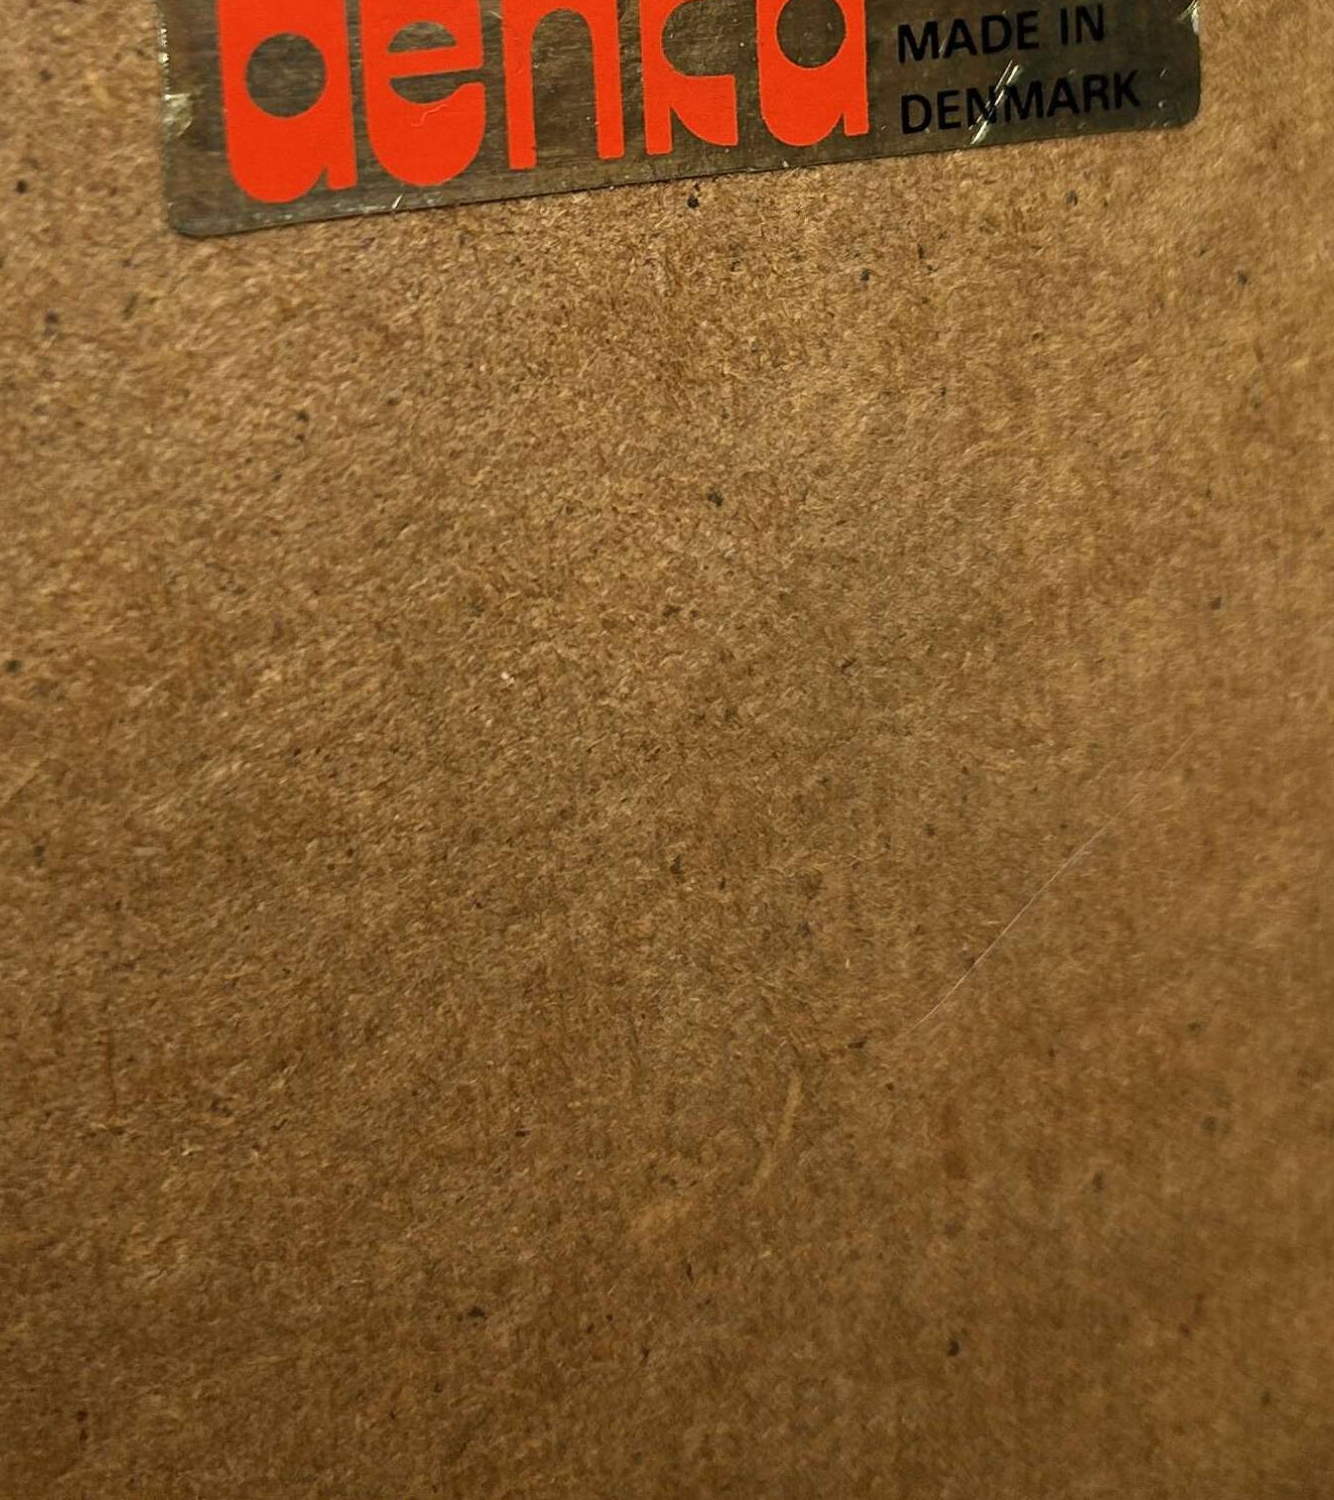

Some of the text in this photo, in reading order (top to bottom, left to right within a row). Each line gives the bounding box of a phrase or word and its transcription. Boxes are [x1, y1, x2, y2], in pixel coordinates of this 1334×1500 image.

[897, 3, 1105, 65] MADE IN
[900, 69, 1141, 135] DENMARK
